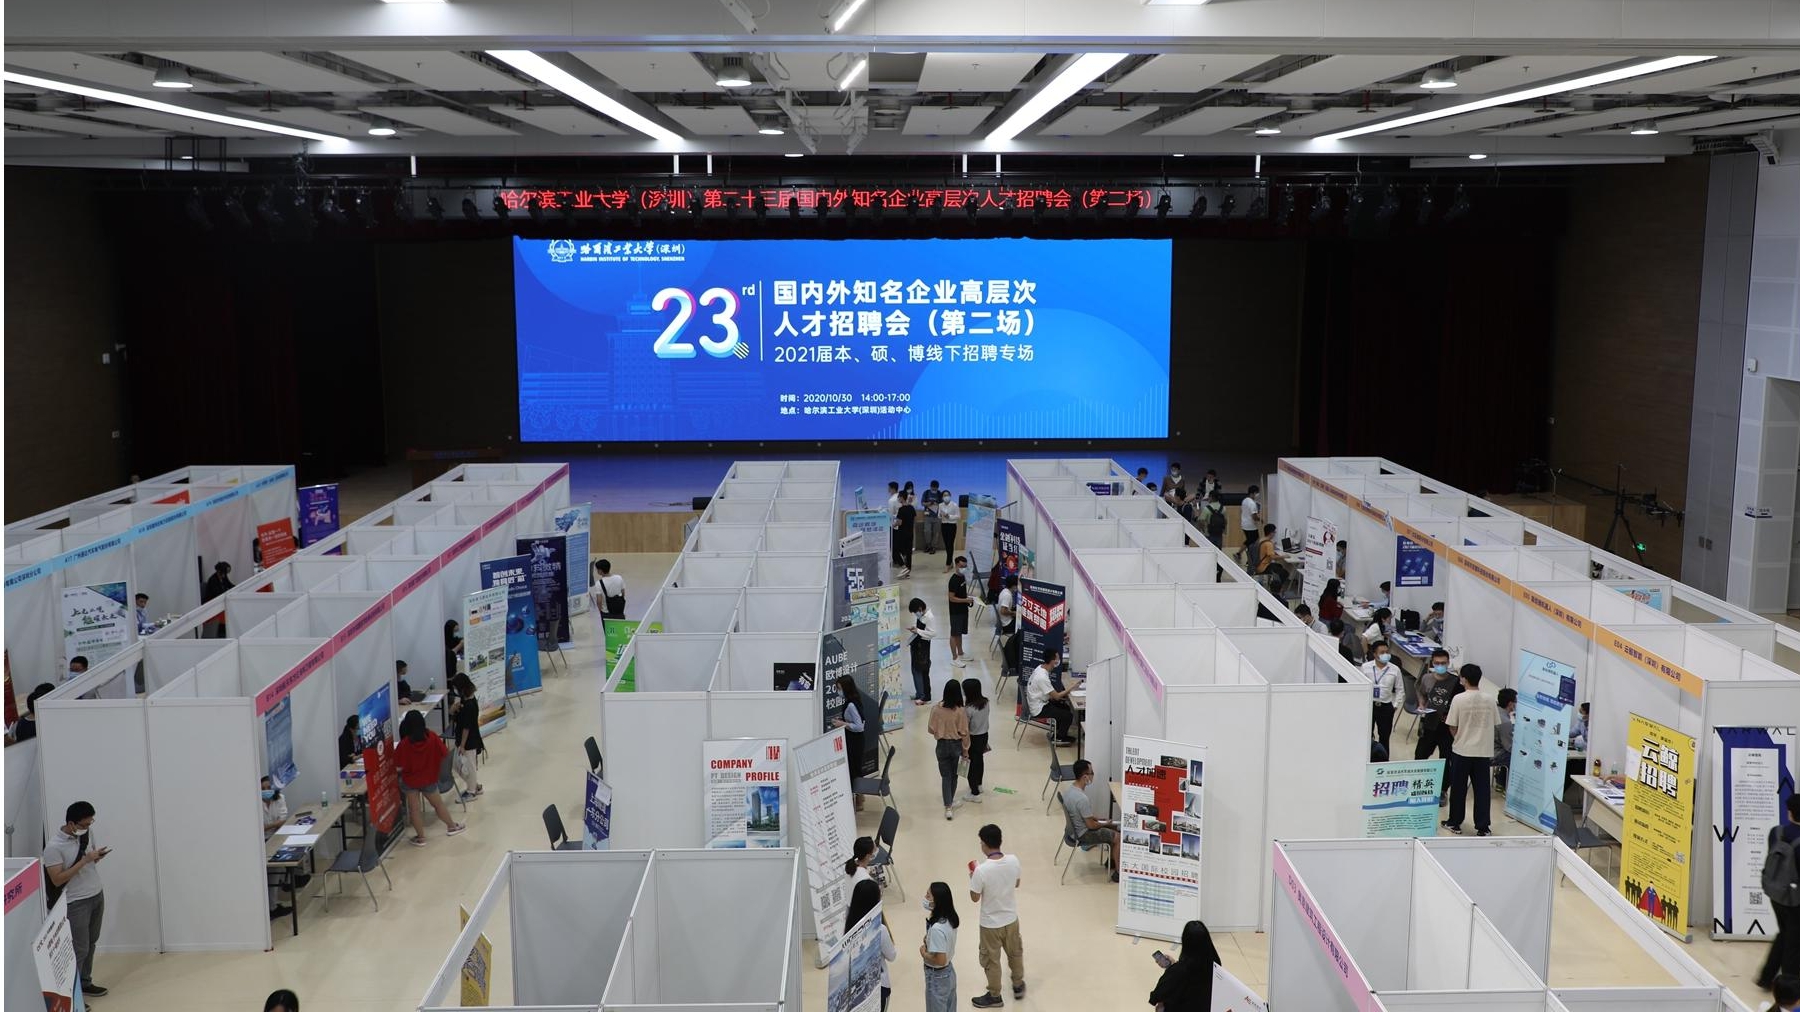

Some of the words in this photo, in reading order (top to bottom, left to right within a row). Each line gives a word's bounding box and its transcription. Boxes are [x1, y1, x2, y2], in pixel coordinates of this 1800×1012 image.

[774, 280, 1037, 306] 国内外知名企业高层次
[774, 311, 1036, 337] 人才招聘会（第二场）
[774, 345, 1034, 363] 2021届本、硕、博线下招聘专场
[825, 651, 848, 666] AUBE
[825, 662, 858, 681] 欧博设计
[364, 729, 376, 742] YOU
[711, 759, 753, 769] COMPANY
[745, 771, 780, 781] PROFILE
[1640, 761, 1678, 799] 招聘
[1373, 780, 1409, 798] 招聘
[1413, 778, 1435, 790] 精英
